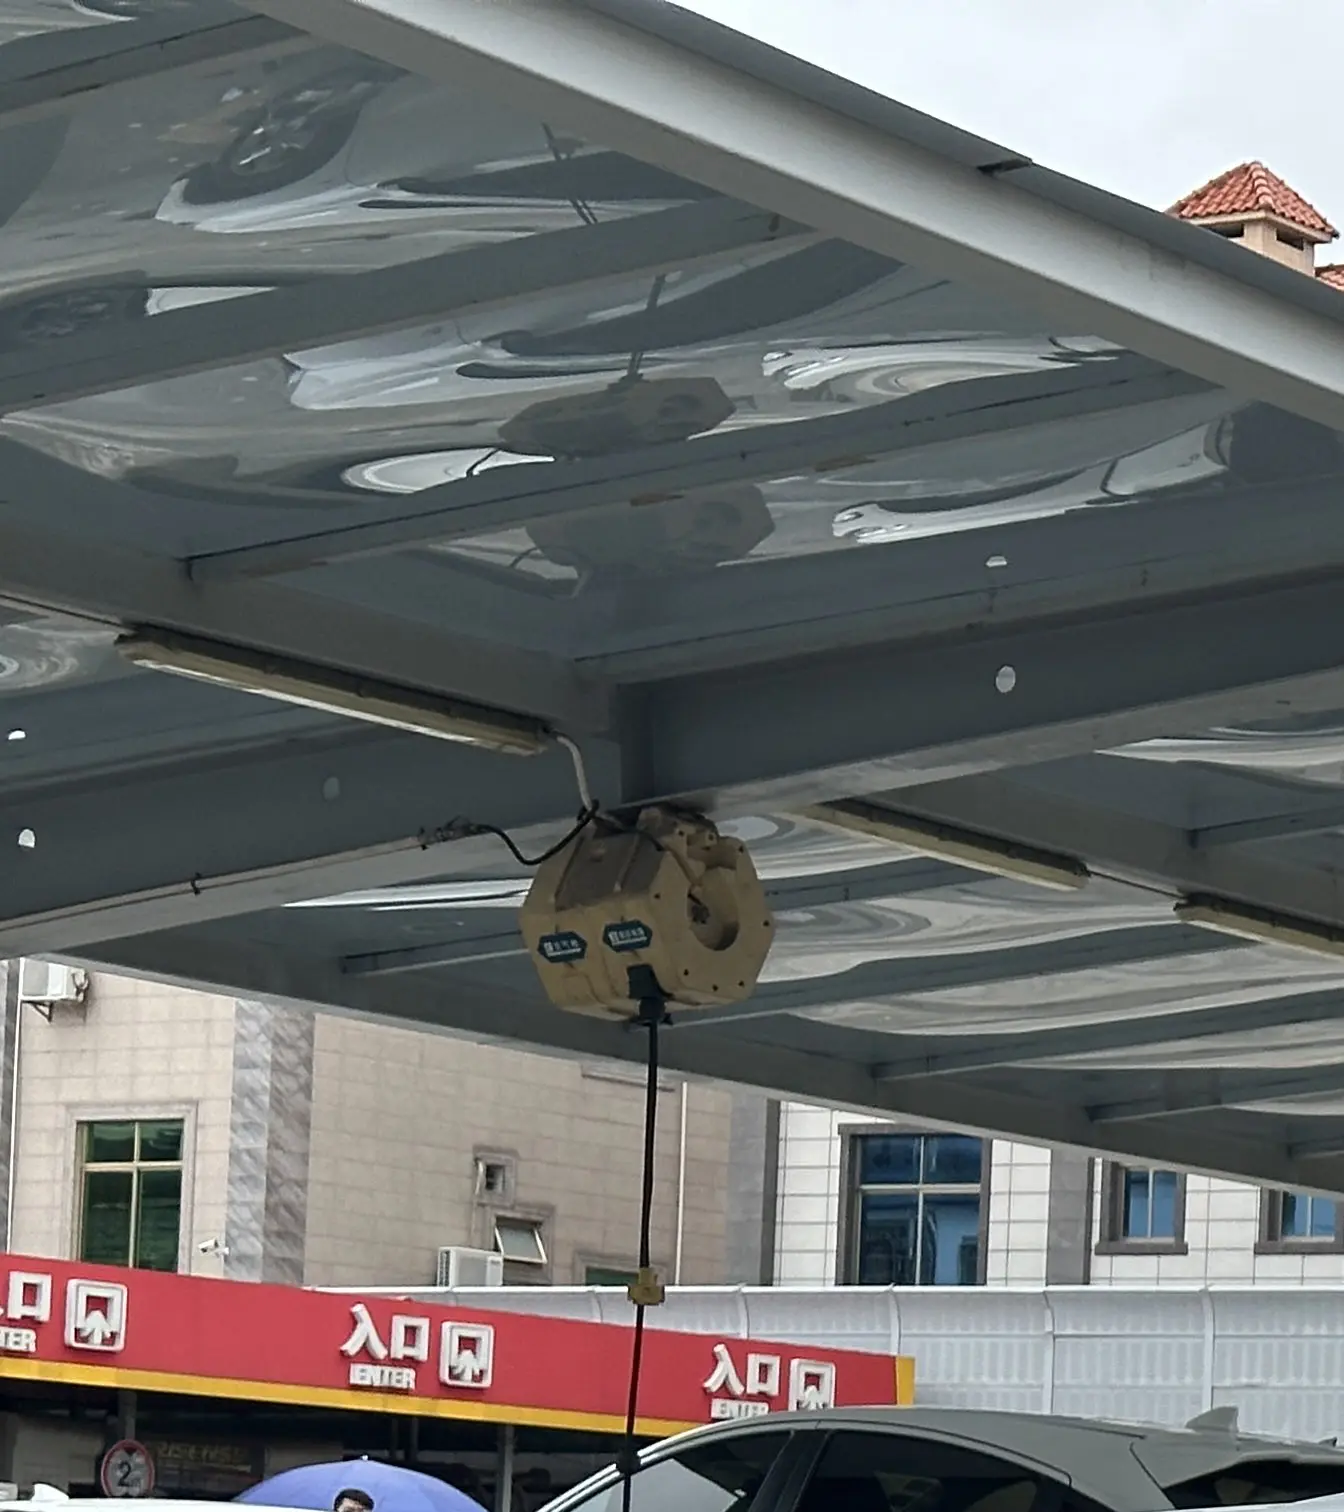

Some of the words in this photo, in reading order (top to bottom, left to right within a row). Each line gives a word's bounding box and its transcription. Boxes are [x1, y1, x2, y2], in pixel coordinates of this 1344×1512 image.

[340, 1303, 430, 1361] 入口
[350, 1362, 416, 1391] ENTER
[703, 1343, 780, 1396] 入口
